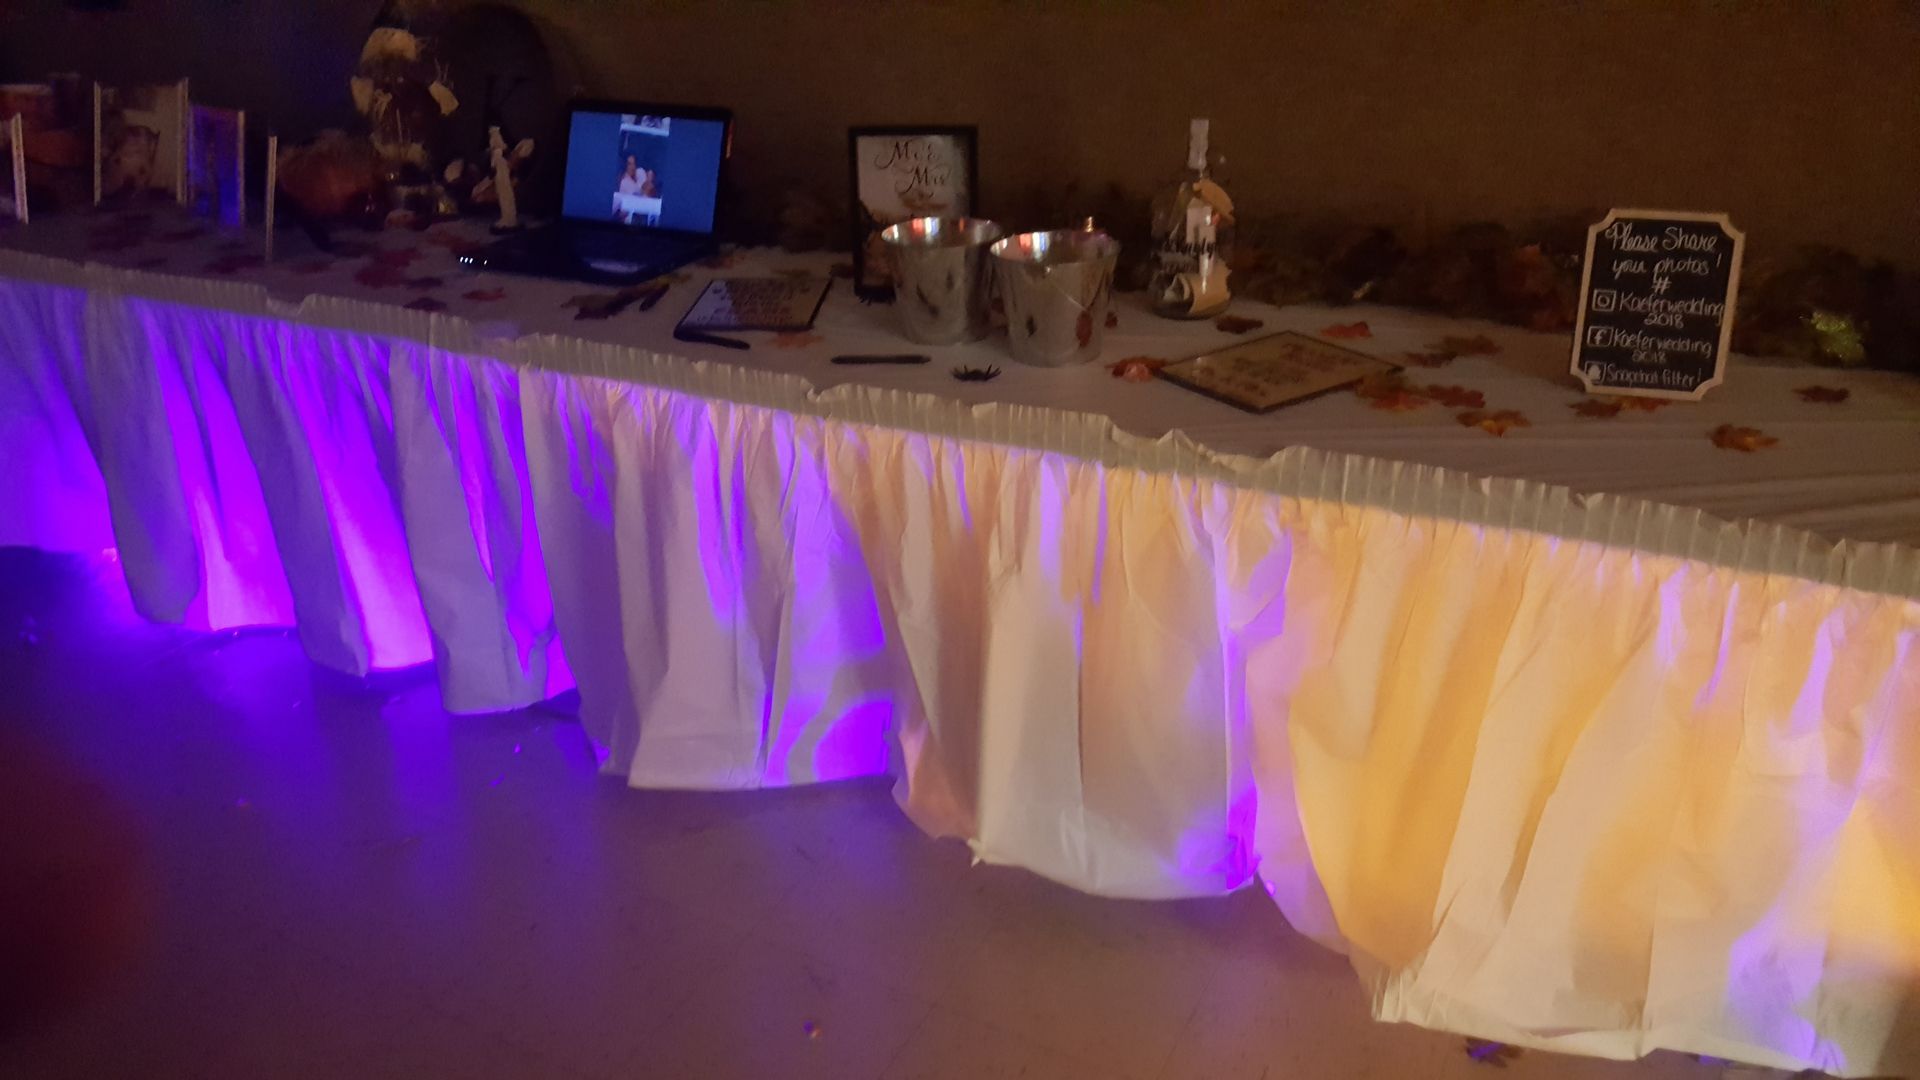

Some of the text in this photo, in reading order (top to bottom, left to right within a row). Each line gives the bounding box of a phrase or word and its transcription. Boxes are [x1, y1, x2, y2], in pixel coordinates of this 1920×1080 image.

[1604, 221, 1719, 253] Please Share
[1643, 312, 1685, 330] 2018
